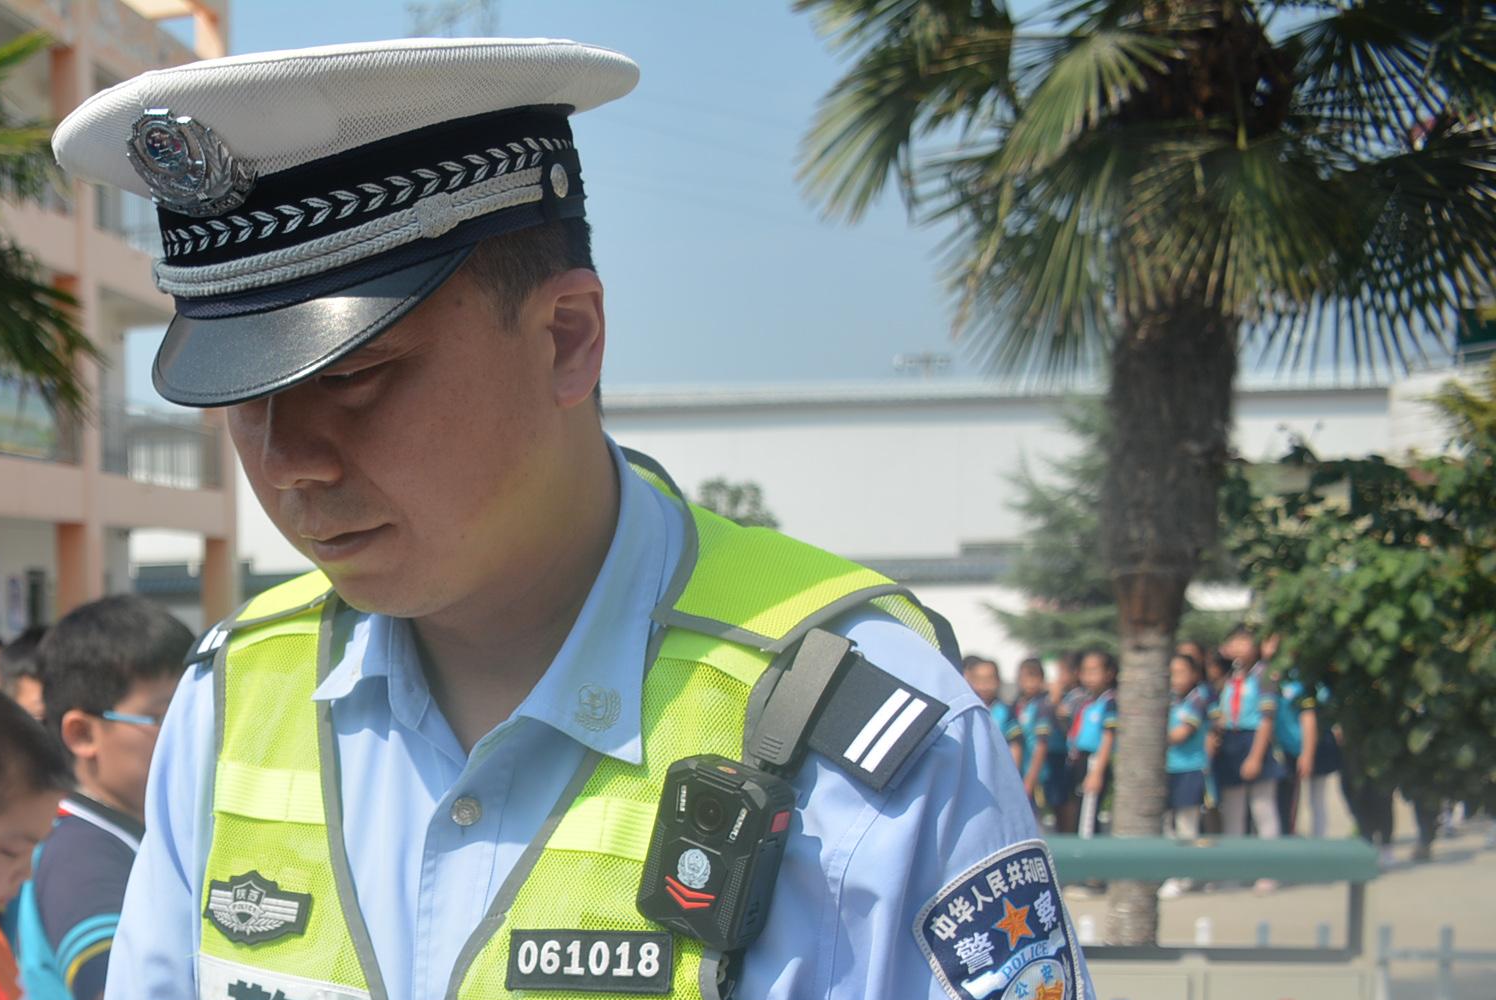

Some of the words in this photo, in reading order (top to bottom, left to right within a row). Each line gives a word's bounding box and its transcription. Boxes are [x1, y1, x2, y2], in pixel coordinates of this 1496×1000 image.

[930, 857, 1050, 942] 中华人民共和国
[517, 940, 661, 978] 061018
[953, 931, 995, 974] 警
[1034, 890, 1056, 931] 察
[1002, 942, 1051, 979] POLICE
